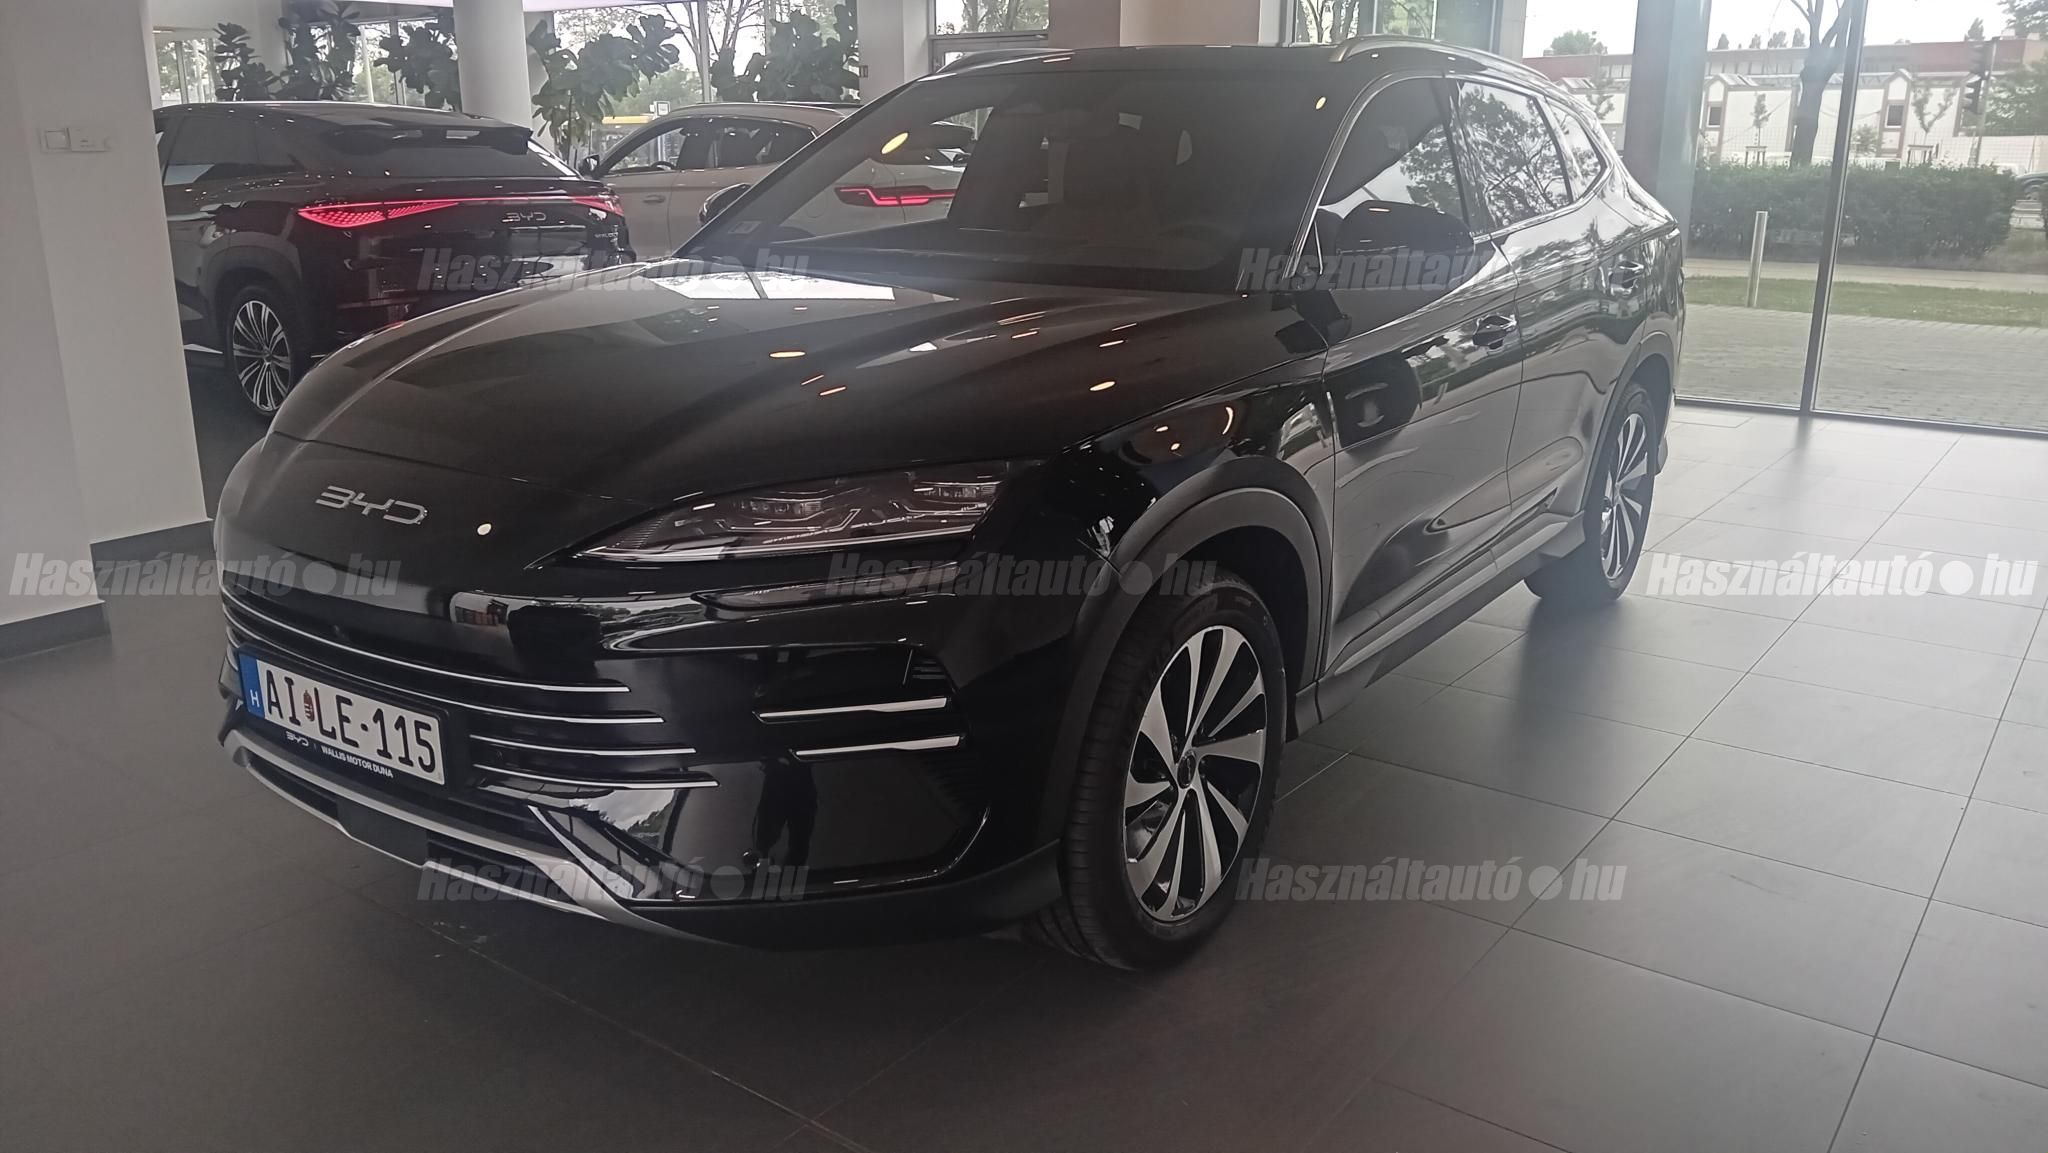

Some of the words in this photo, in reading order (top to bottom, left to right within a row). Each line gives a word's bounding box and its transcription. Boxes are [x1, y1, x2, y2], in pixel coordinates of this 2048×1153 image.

[315, 485, 428, 525] BYD
[320, 744, 347, 762] WALLIS
[346, 753, 374, 771] MOTOR
[372, 762, 395, 779] DUNA
